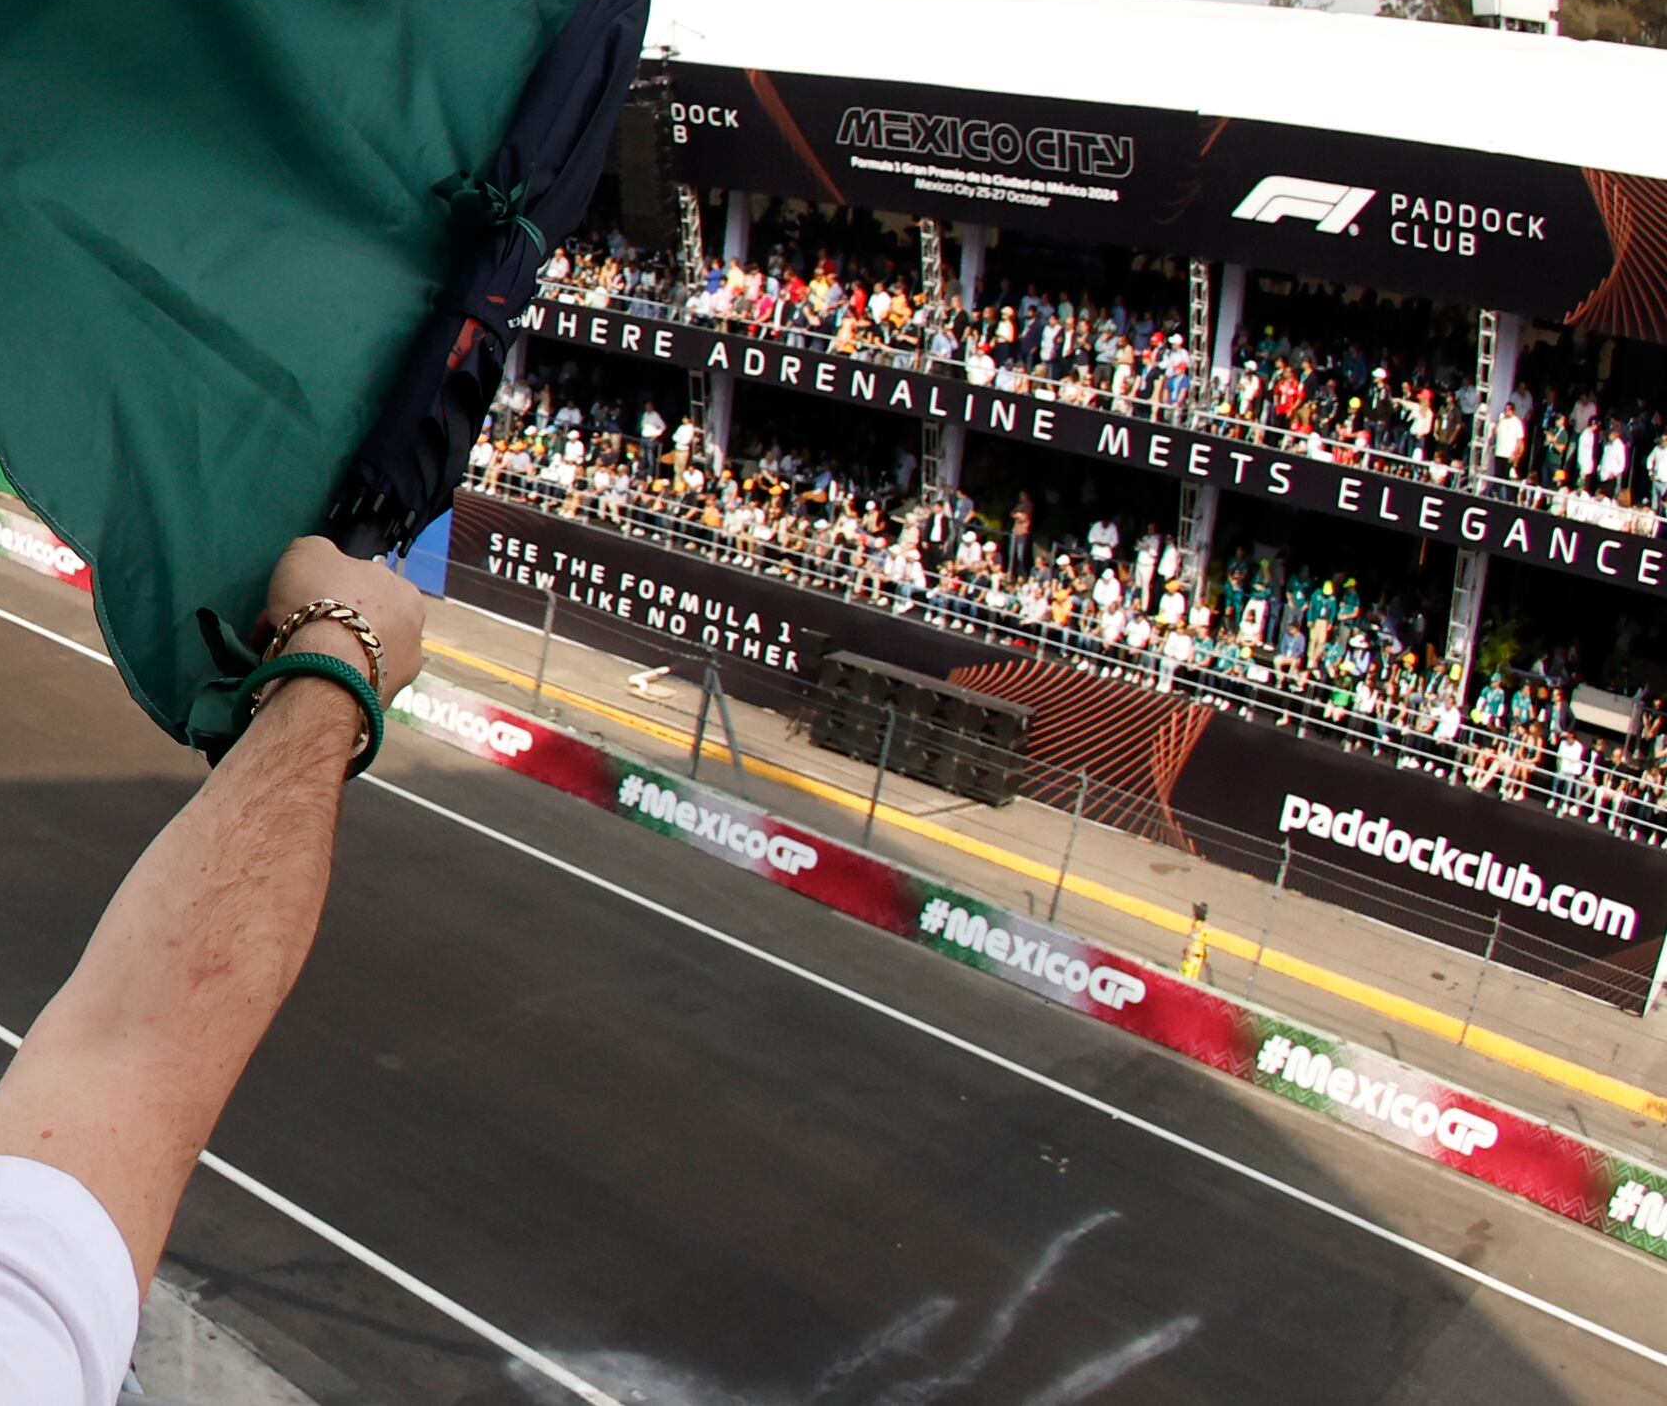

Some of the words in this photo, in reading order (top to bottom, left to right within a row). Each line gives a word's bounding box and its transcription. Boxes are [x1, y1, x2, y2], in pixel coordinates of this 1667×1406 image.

[670, 102, 739, 128] DOCK
[836, 107, 1022, 165] MEXICO
[1026, 126, 1134, 179] CITY
[850, 155, 894, 173] Formula
[902, 162, 927, 176] Gran
[928, 165, 965, 183] Premio
[967, 170, 981, 184] de
[981, 172, 992, 186] la
[992, 173, 1031, 191] Ciudad
[1031, 178, 1046, 192] de
[1088, 186, 1119, 202] 2024
[954, 182, 975, 199] City
[976, 185, 1006, 201] 25-27
[1007, 190, 1051, 207] October
[1391, 193, 1546, 241] PADDOCK
[1390, 221, 1476, 257] CLUB
[522, 306, 674, 358] WHERE
[707, 341, 1057, 442] ADRENALINE
[1097, 423, 1294, 494] MEETS
[1339, 478, 1665, 586] ELEGANCE
[488, 555, 556, 592] VIEW
[570, 581, 633, 618] LIKE
[647, 606, 687, 636] NO
[702, 625, 800, 674] OTHER
[489, 532, 538, 564] SEE
[554, 551, 606, 584] THE
[621, 573, 761, 635] FORMULA
[779, 621, 791, 644] 1
[619, 773, 819, 876] #MexicoGP
[1279, 793, 1638, 943] paddockclub.com
[920, 896, 1147, 1011] #MexicoGP
[1257, 1034, 1499, 1157] #MexicoGP
